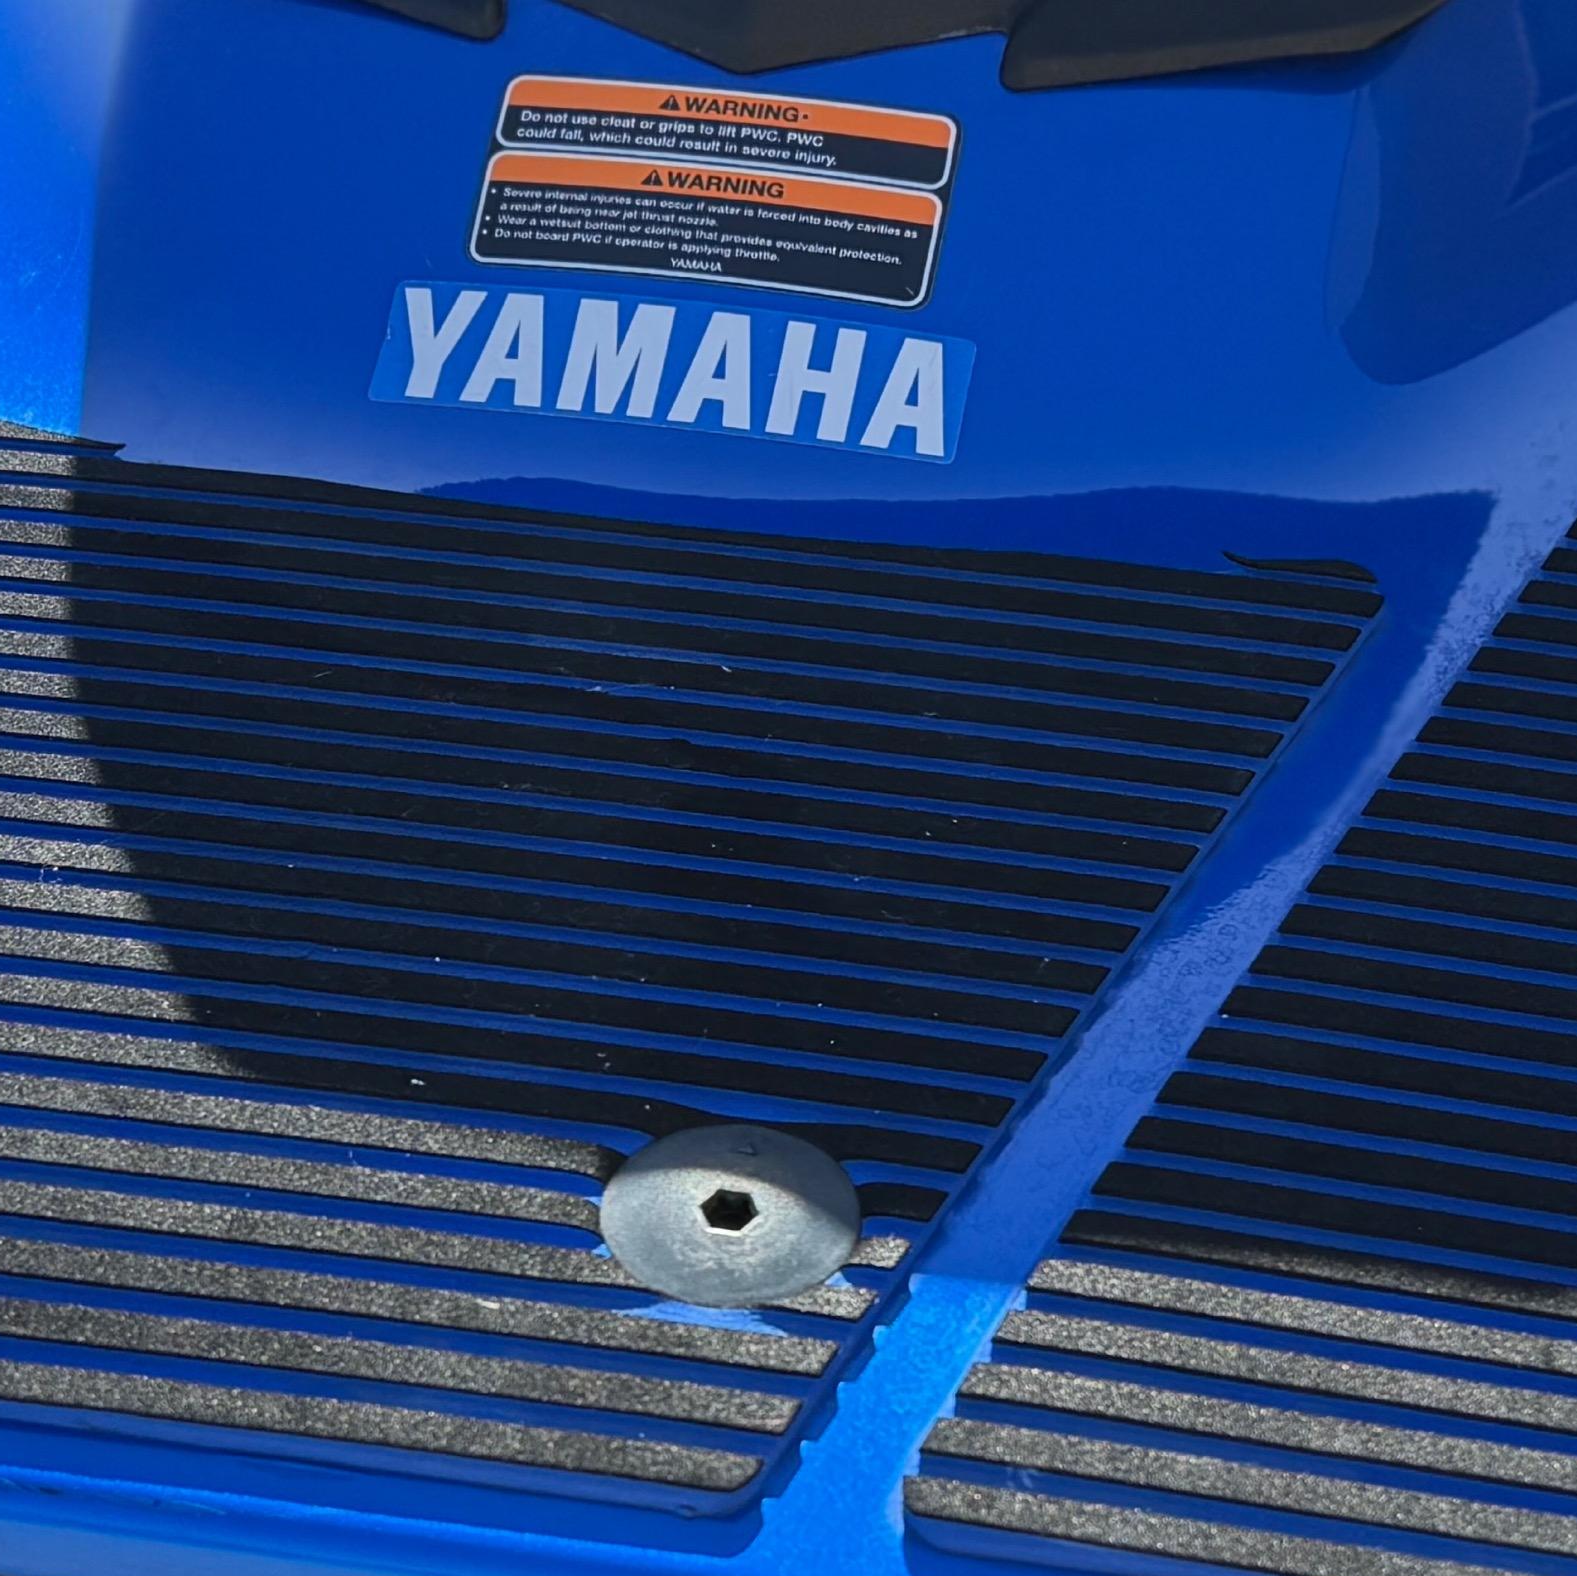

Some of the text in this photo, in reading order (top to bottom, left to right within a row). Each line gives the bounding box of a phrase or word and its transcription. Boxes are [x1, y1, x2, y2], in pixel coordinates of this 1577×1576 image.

[685, 96, 799, 123] WARNING
[517, 127, 837, 167] could fall, which could result in severe injury.
[520, 110, 824, 148] Do not use cleat or grips to lift PWC. PWC
[668, 171, 784, 199] WARNING
[499, 202, 508, 210] a
[509, 202, 542, 213] result
[544, 204, 557, 213] of
[559, 204, 591, 217] being
[595, 208, 621, 217] near
[622, 210, 638, 220] jet
[641, 210, 675, 223] thrust
[503, 187, 918, 239] Severe internal injuries can occur if water is forced into body cavities as
[495, 228, 780, 262] Do not board PWC if operator is applying throttle.
[498, 214, 902, 265] Wear a wetsuit bottom or clothing that provides equivalent protection.
[404, 287, 945, 458] YAMAHA
